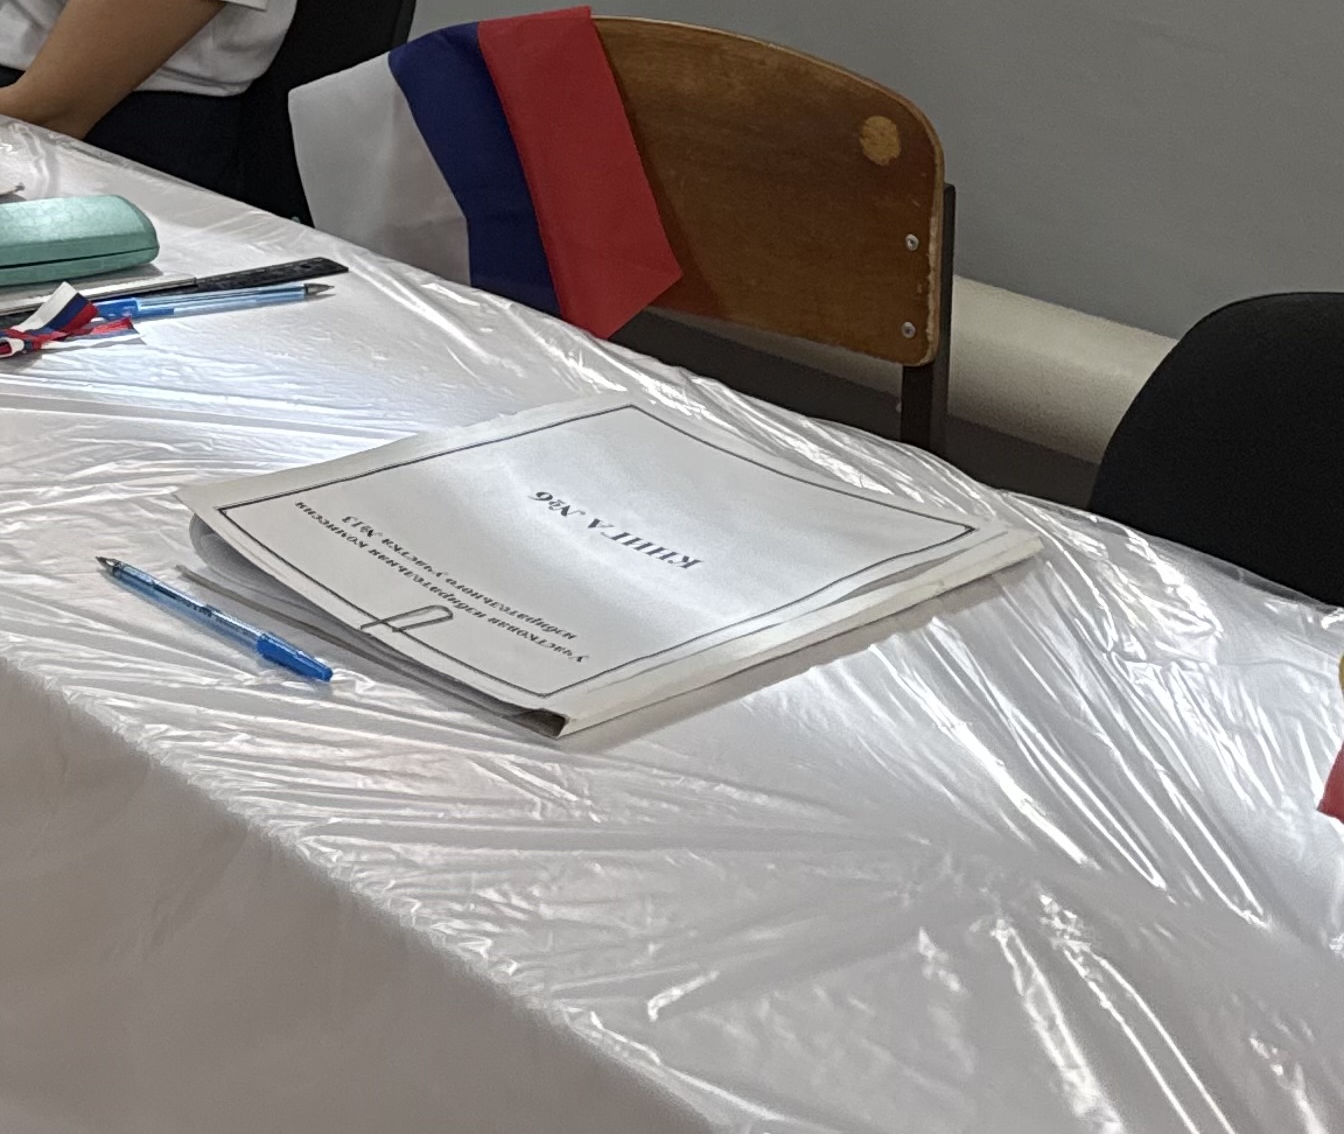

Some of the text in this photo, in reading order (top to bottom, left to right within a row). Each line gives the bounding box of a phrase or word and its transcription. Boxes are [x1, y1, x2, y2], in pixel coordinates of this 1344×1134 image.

[294, 500, 590, 664] Участковая избирательная комиссия
[341, 514, 578, 641] избирательного участка №13
[528, 491, 703, 569] КНИГА №6
